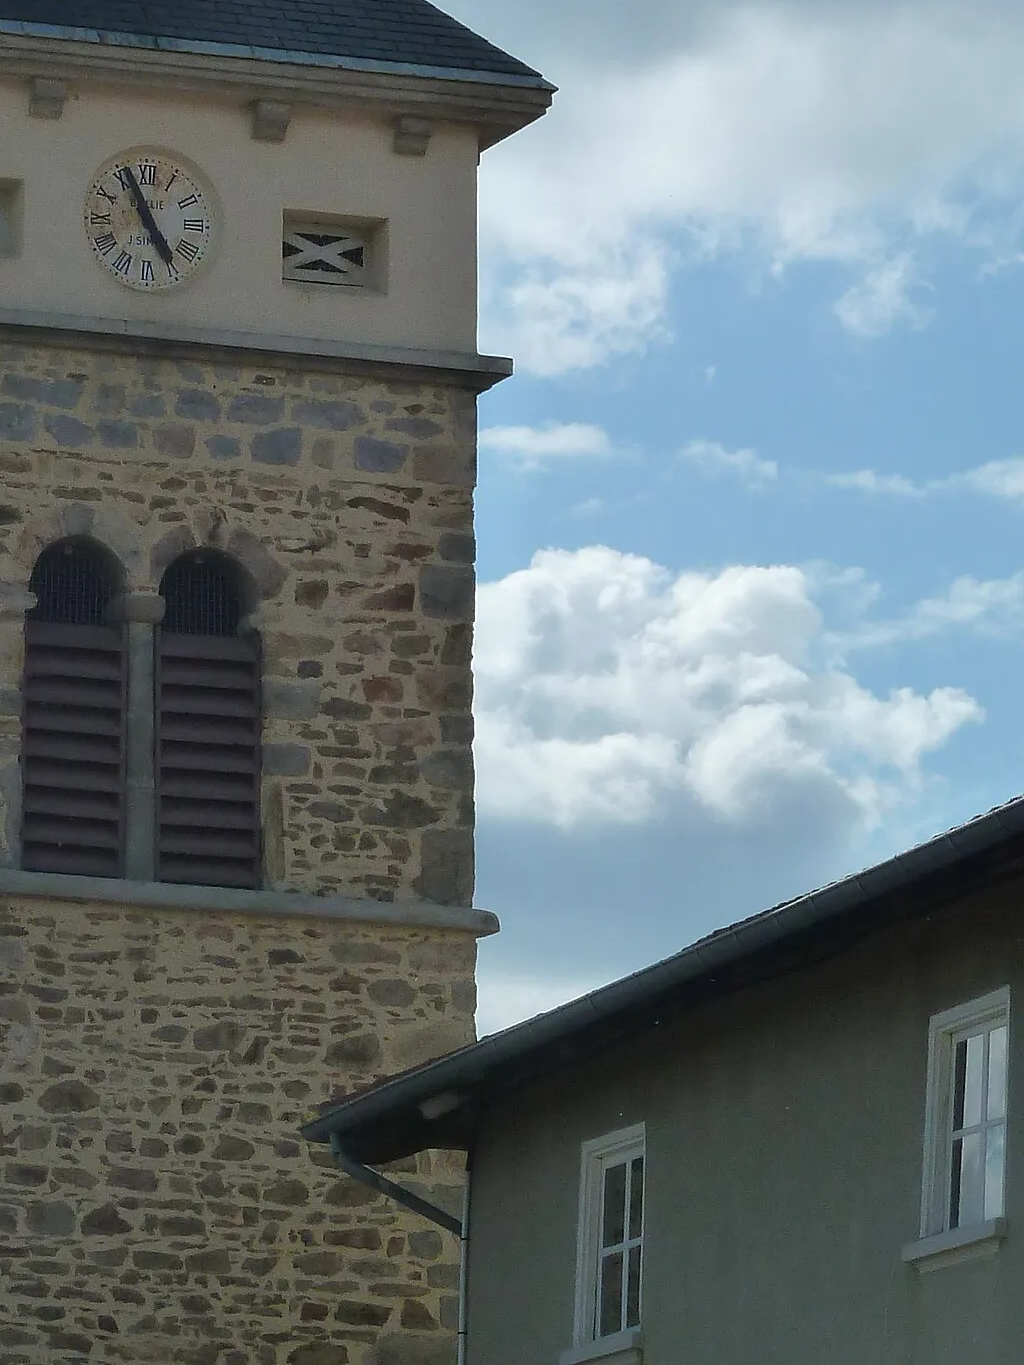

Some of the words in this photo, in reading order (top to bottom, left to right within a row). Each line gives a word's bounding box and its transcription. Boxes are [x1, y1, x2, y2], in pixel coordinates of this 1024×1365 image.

[138, 164, 157, 186] XII
[164, 173, 178, 192] I
[95, 185, 118, 206] X
[177, 194, 199, 210] II
[183, 219, 204, 233] III
[175, 238, 200, 263] IIII
[141, 259, 155, 282] VI
